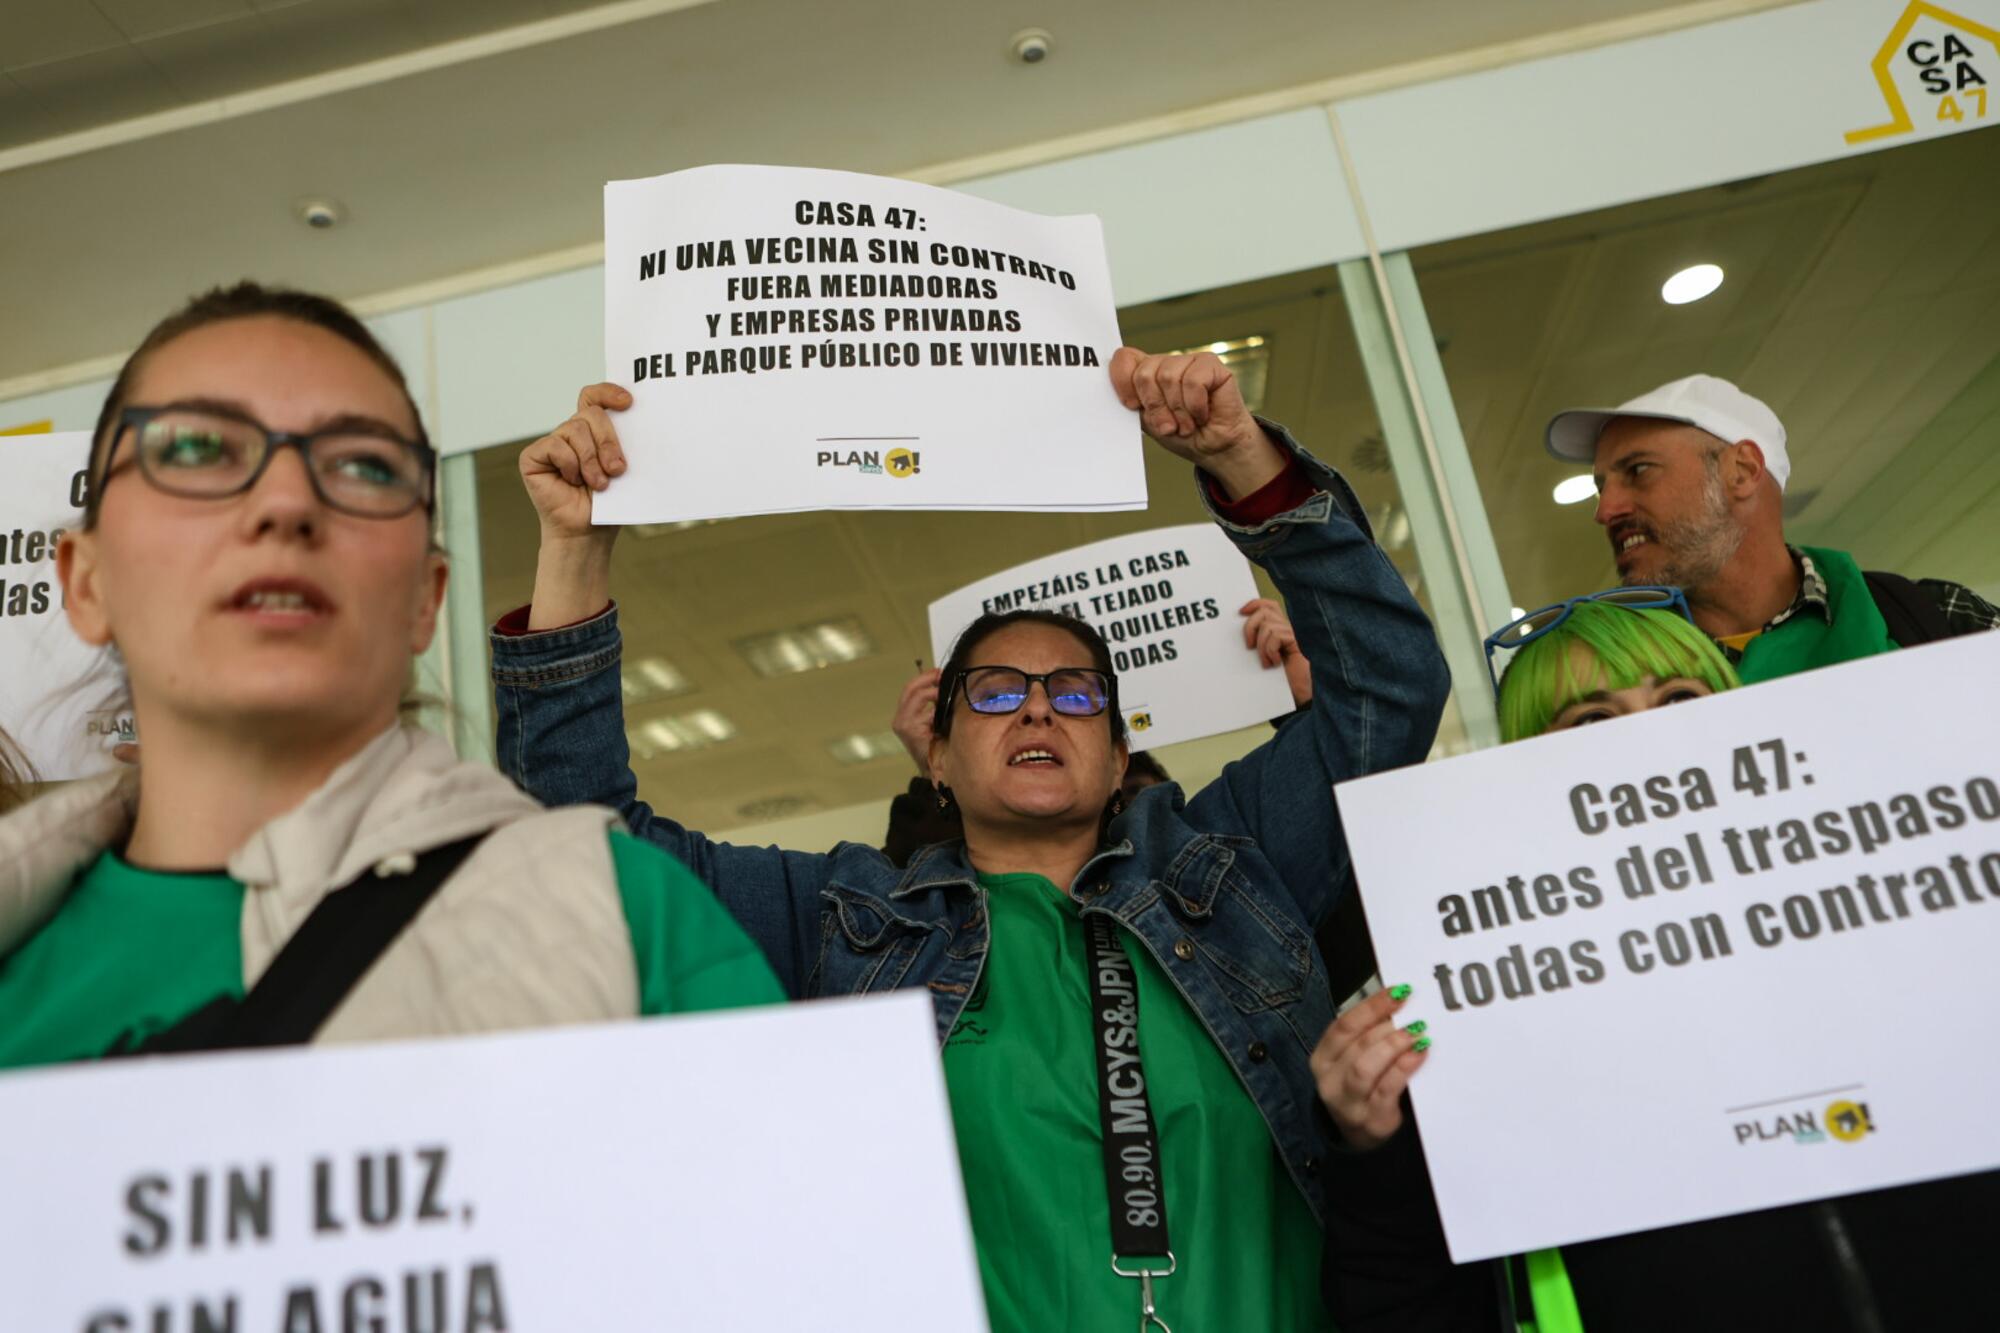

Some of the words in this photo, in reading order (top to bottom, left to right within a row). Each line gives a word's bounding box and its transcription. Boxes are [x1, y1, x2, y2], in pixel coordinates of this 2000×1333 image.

[1907, 33, 1973, 66] CA
[1920, 61, 1986, 94] SA
[1936, 88, 1986, 122] 47
[795, 200, 876, 227] CASA
[884, 207, 926, 231] 47:
[640, 249, 666, 281] NI
[676, 240, 736, 271] UNA
[745, 237, 859, 264] VECINA
[868, 238, 919, 264] SIN
[930, 243, 1076, 291] CONTRATO
[727, 275, 812, 301] FUERA
[820, 274, 998, 300] MEDIADORAS
[706, 313, 721, 338] Y
[730, 308, 875, 336] EMPRESAS
[885, 308, 1021, 332] PRIVADAS
[634, 353, 676, 383] DEL
[686, 345, 792, 374] PARQUE
[801, 339, 920, 369] PÚBLICO
[930, 342, 963, 366] DE
[970, 342, 1100, 367] VIVIENDA
[817, 450, 880, 467] PLAN
[982, 574, 1090, 614] EMPEZÁIS
[1095, 563, 1124, 586] LA
[1128, 550, 1190, 577] CASA
[1089, 580, 1174, 616] TEJADO
[1098, 598, 1220, 644] LQUILERES
[1113, 639, 1178, 672] ODAS
[87, 718, 134, 737] PLAN
[1569, 766, 1718, 836] Casa
[1732, 738, 1816, 797] 47:
[1437, 866, 1604, 938] antes
[1615, 832, 1714, 900] del
[1721, 776, 2000, 876] traspaso
[1433, 944, 1606, 1012] todas
[1618, 912, 1733, 974] con
[1096, 949, 1150, 1135] MCYS&JPN
[1734, 1109, 1818, 1146] PLAN
[123, 1163, 272, 1259] SIN
[313, 1145, 475, 1238] LUZ,
[1120, 1139, 1159, 1227] 80.90.
[282, 1259, 510, 1333] AGUA
